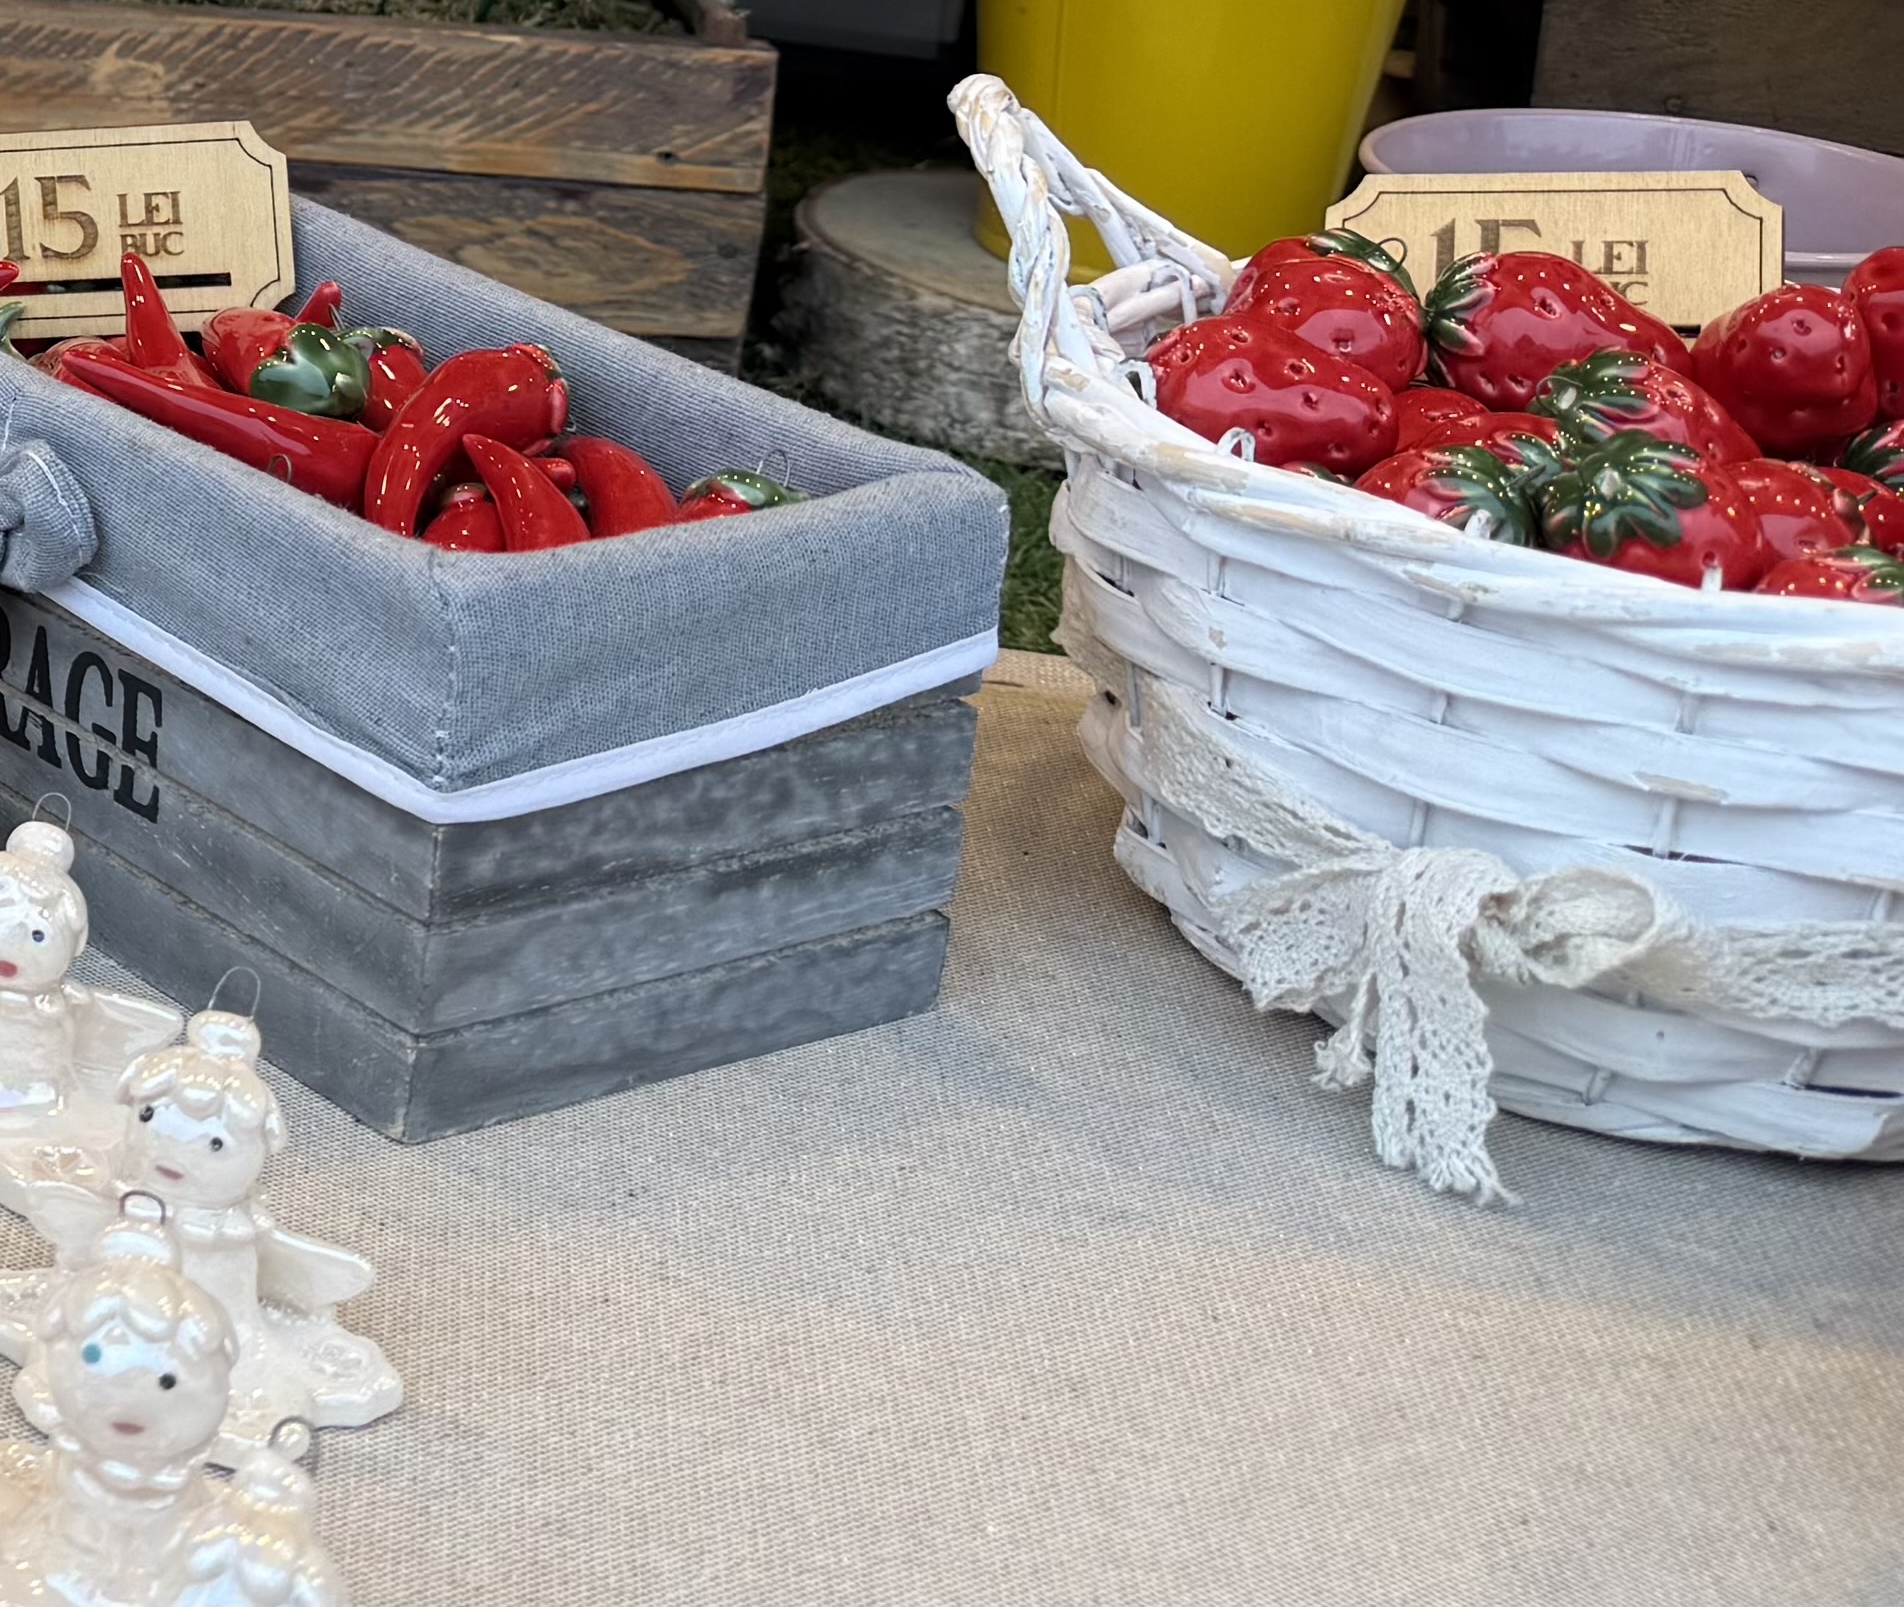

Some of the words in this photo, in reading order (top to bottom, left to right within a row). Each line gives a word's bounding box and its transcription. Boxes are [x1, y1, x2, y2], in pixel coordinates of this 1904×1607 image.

[116, 190, 184, 228] LEI
[119, 231, 185, 257] BUC
[1570, 240, 1650, 274] LEI
